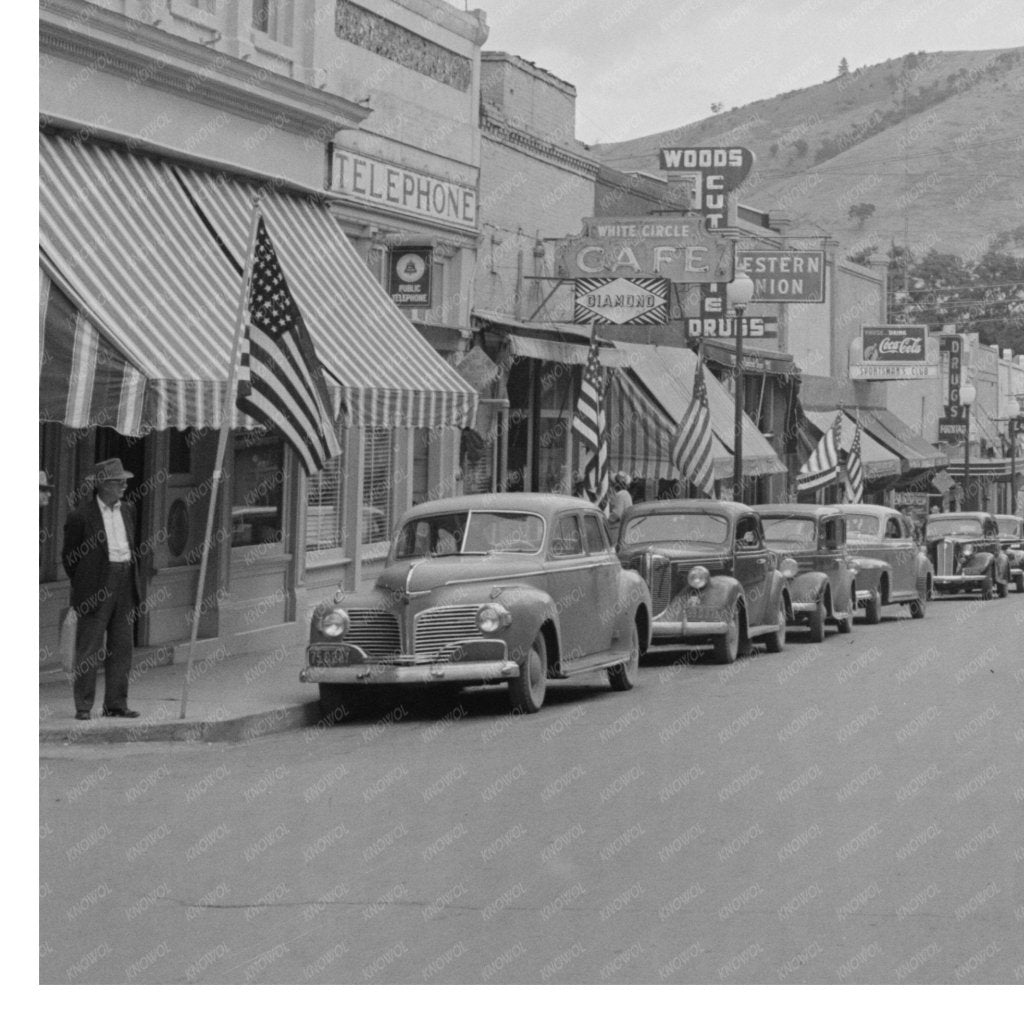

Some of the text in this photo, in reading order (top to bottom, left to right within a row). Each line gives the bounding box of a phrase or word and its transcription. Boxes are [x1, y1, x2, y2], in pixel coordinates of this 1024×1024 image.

[663, 149, 743, 167] WOODS
[335, 152, 475, 223] TELEPHONE
[706, 175, 724, 229] CUT
[597, 225, 690, 237] WHITE CIRCLE
[576, 246, 709, 273] CAFE
[399, 284, 421, 293] PUBLIC
[755, 278, 803, 294] NION
[392, 293, 428, 303] TELEPHONE
[586, 294, 655, 308] DIAMOND
[950, 340, 961, 418] DRUGS
